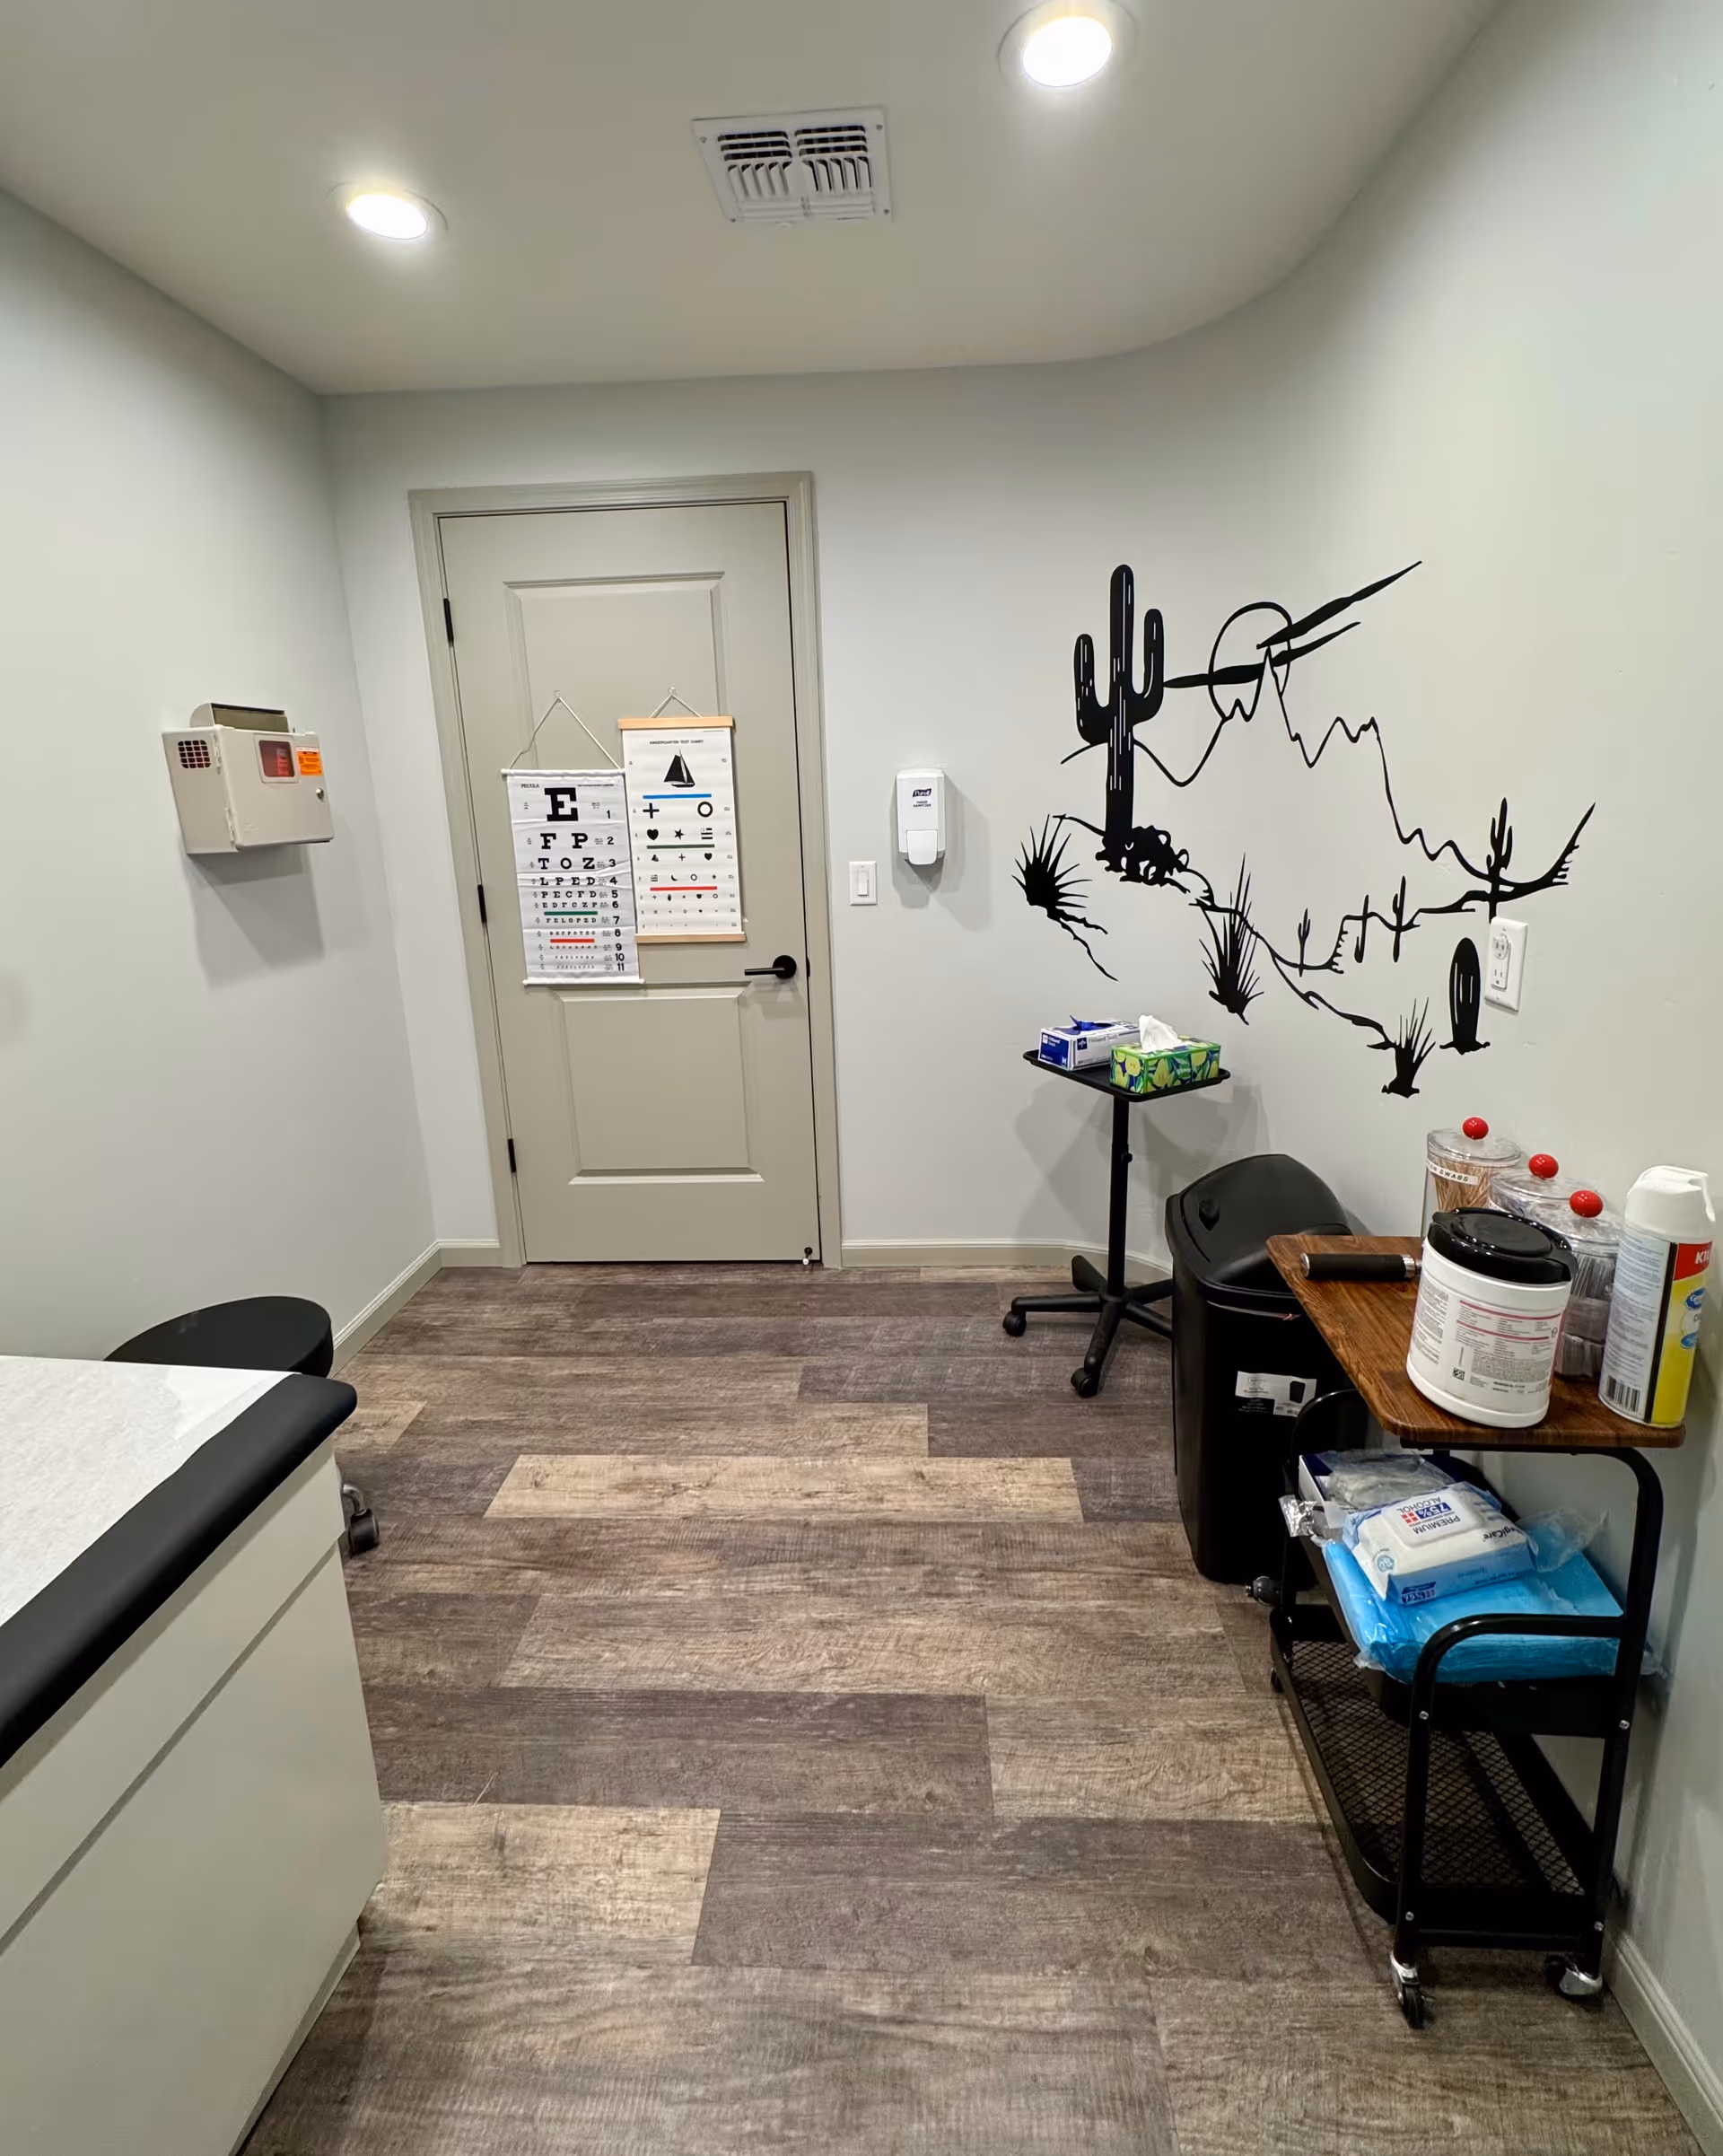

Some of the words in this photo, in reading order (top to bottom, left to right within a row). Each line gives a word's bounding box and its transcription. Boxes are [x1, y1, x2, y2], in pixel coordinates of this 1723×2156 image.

[544, 787, 579, 822] E
[606, 810, 611, 819] 1
[607, 837, 614, 845] 2
[608, 859, 616, 867] 3
[609, 876, 617, 885] 4
[611, 890, 618, 898] 5
[613, 916, 620, 925] 7
[616, 942, 622, 951] 9
[615, 952, 625, 961] 10
[617, 962, 625, 971] 11
[1439, 1169, 1469, 1182] SWABS
[1396, 1496, 1441, 1513] ALCOHOL
[1419, 1503, 1449, 1518] 75%
[1413, 1515, 1461, 1535] PREMIUM
